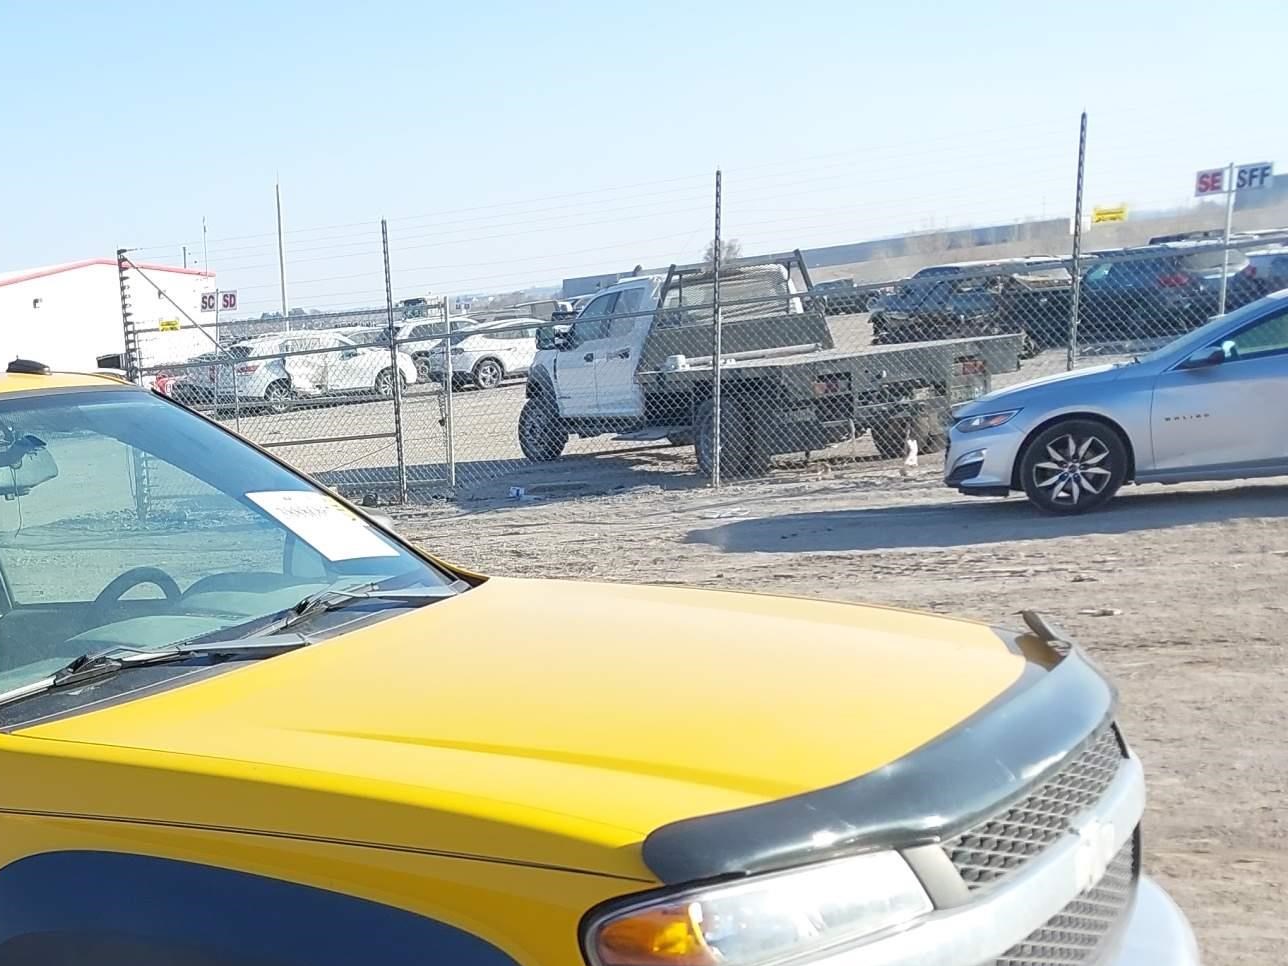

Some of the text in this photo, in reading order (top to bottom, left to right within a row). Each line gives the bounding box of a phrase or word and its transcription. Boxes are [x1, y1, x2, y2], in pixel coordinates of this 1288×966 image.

[1198, 171, 1222, 193] SE
[1237, 165, 1272, 188] SFF
[201, 295, 215, 310] SC
[222, 293, 236, 309] SD
